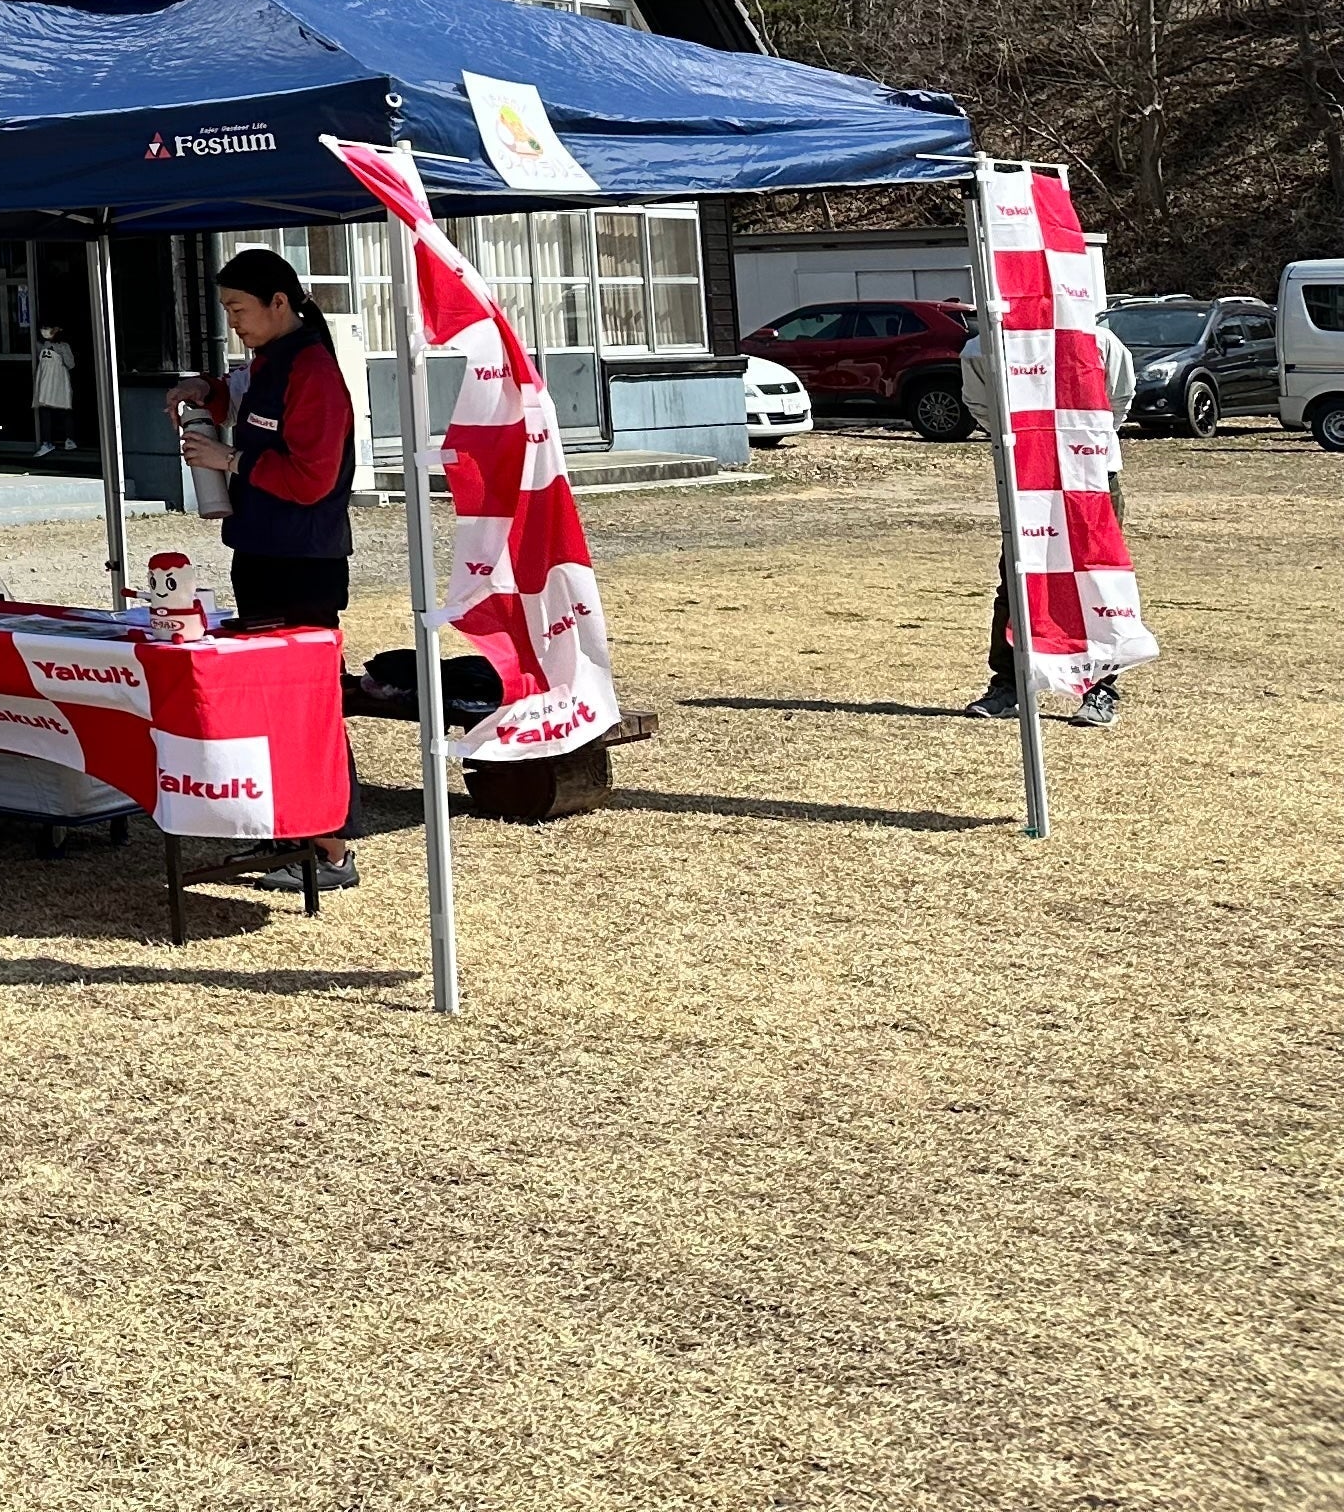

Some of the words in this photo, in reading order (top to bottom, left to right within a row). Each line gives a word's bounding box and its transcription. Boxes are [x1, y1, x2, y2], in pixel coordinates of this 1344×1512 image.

[252, 122, 268, 130] Life
[174, 132, 277, 157] Festum
[32, 660, 140, 687] Yakult
